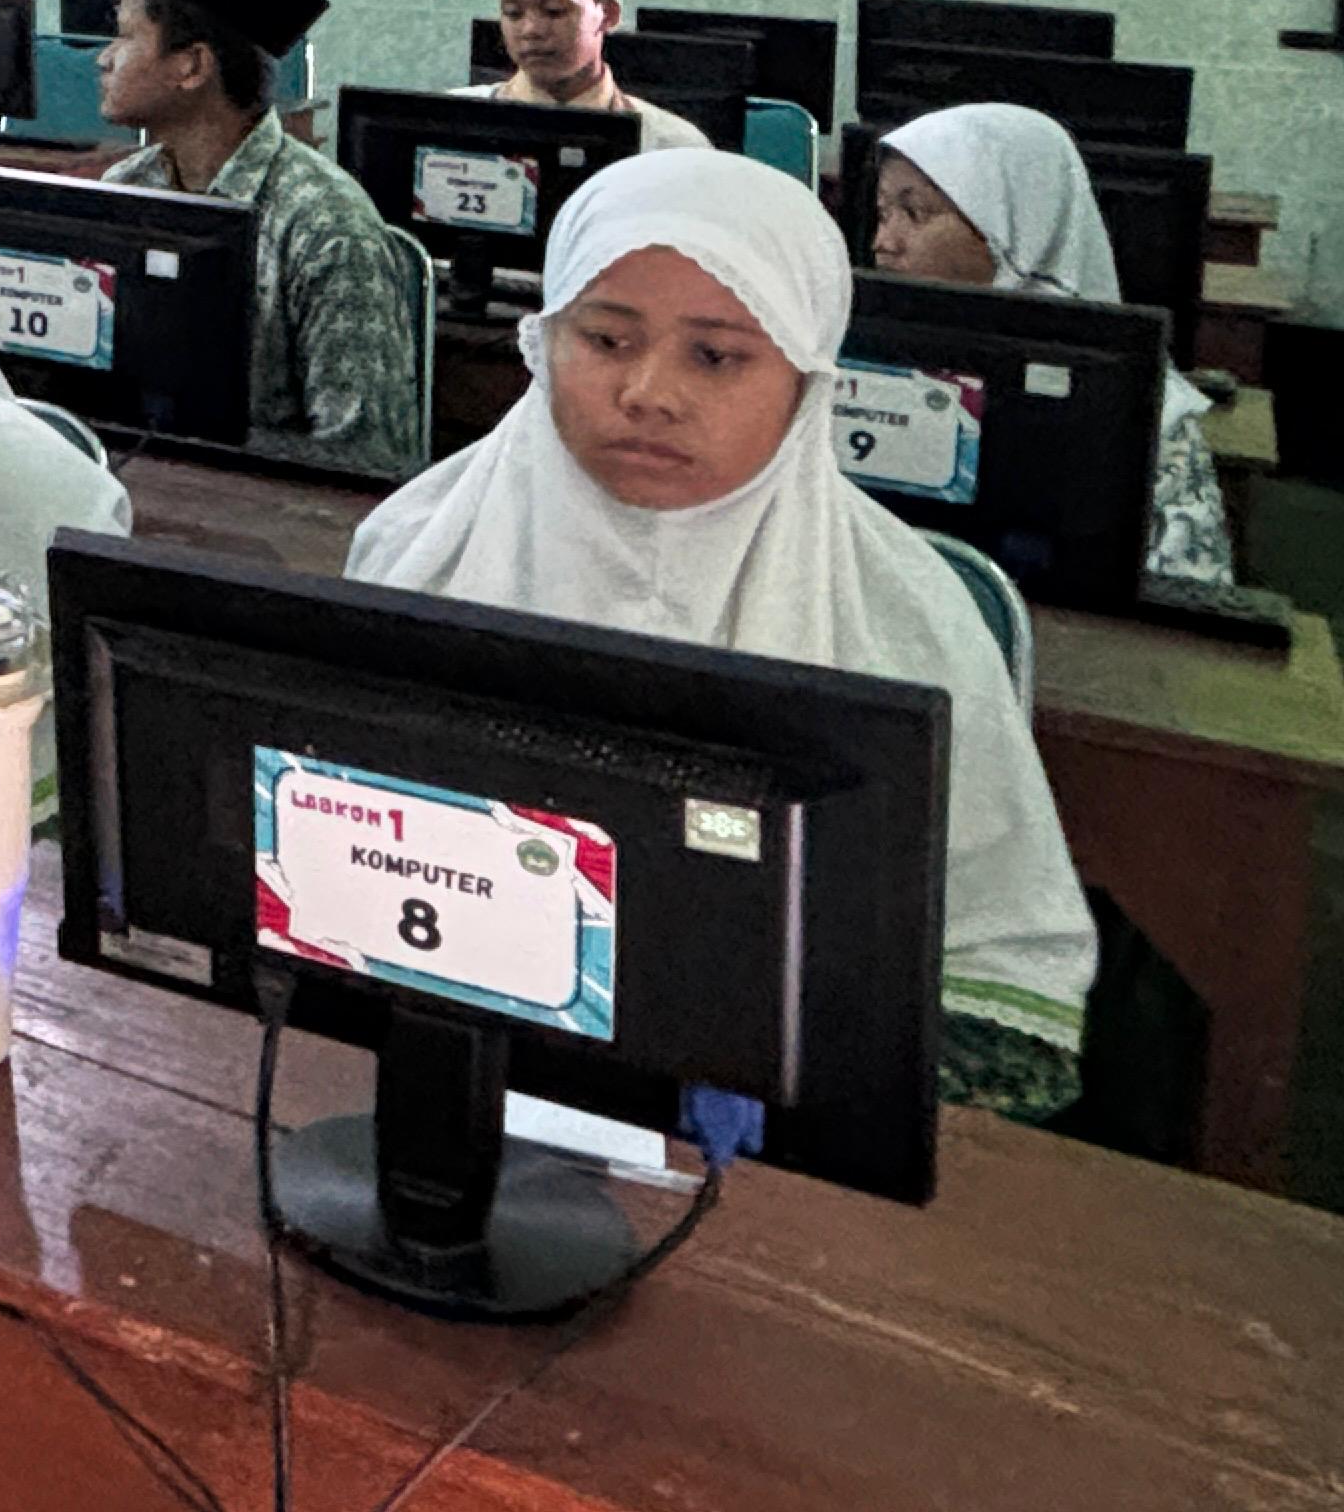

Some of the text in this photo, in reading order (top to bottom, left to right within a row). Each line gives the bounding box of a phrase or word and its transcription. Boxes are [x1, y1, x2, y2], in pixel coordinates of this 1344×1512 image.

[458, 193, 486, 214] 23
[10, 307, 48, 337] 10
[833, 405, 910, 426] OMPUTER
[849, 430, 876, 461] 9
[388, 808, 404, 841] 1
[350, 844, 495, 900] KOMPUTER
[396, 896, 443, 952] 8
